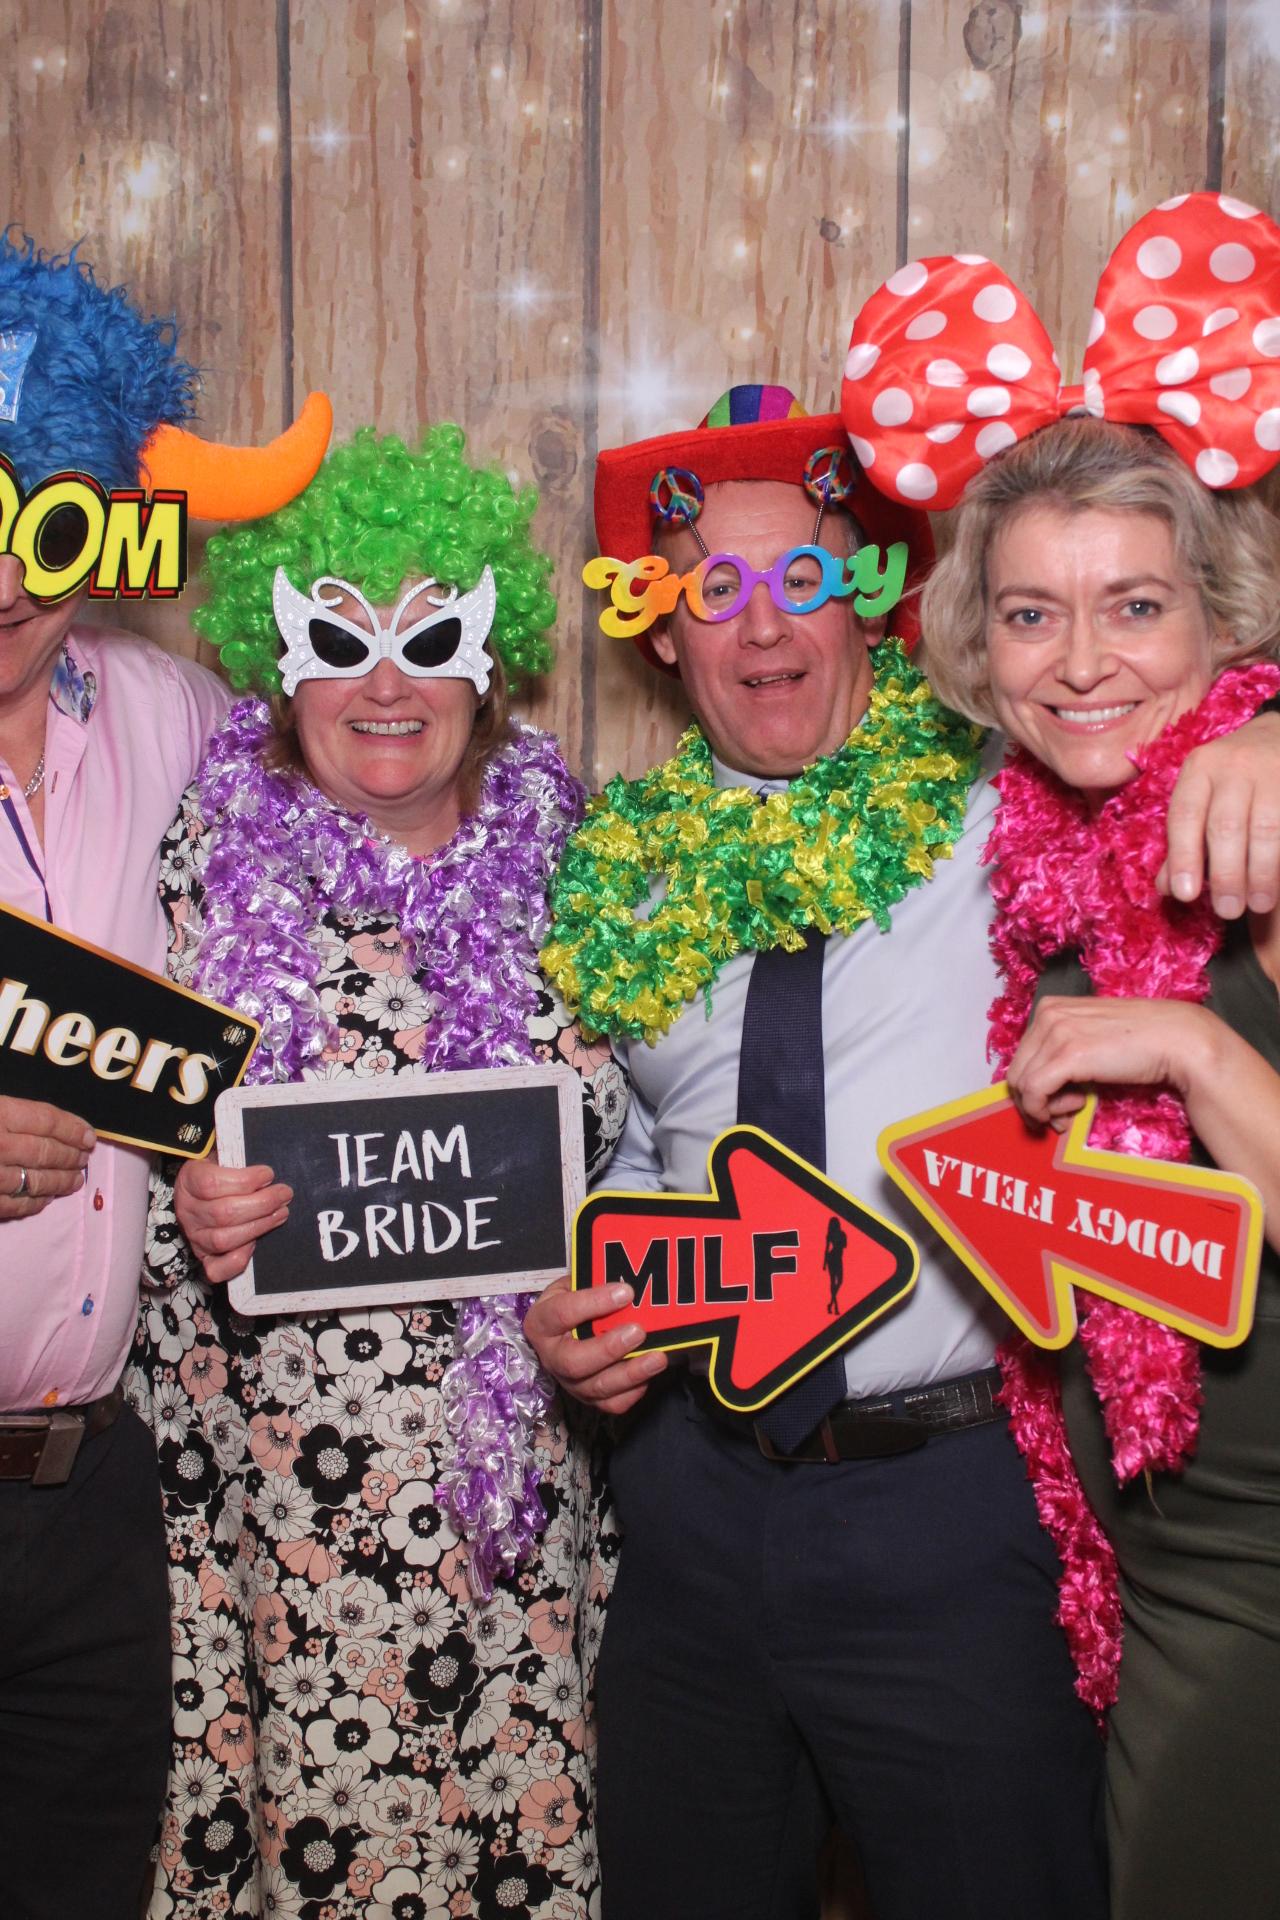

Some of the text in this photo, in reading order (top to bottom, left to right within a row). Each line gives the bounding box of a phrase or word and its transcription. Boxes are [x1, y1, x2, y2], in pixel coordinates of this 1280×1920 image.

[328, 1125, 472, 1187] TEAM
[317, 1196, 502, 1262] BRIDE
[922, 1148, 1226, 1281] DODGY FELLA
[604, 1229, 800, 1308] MILF
